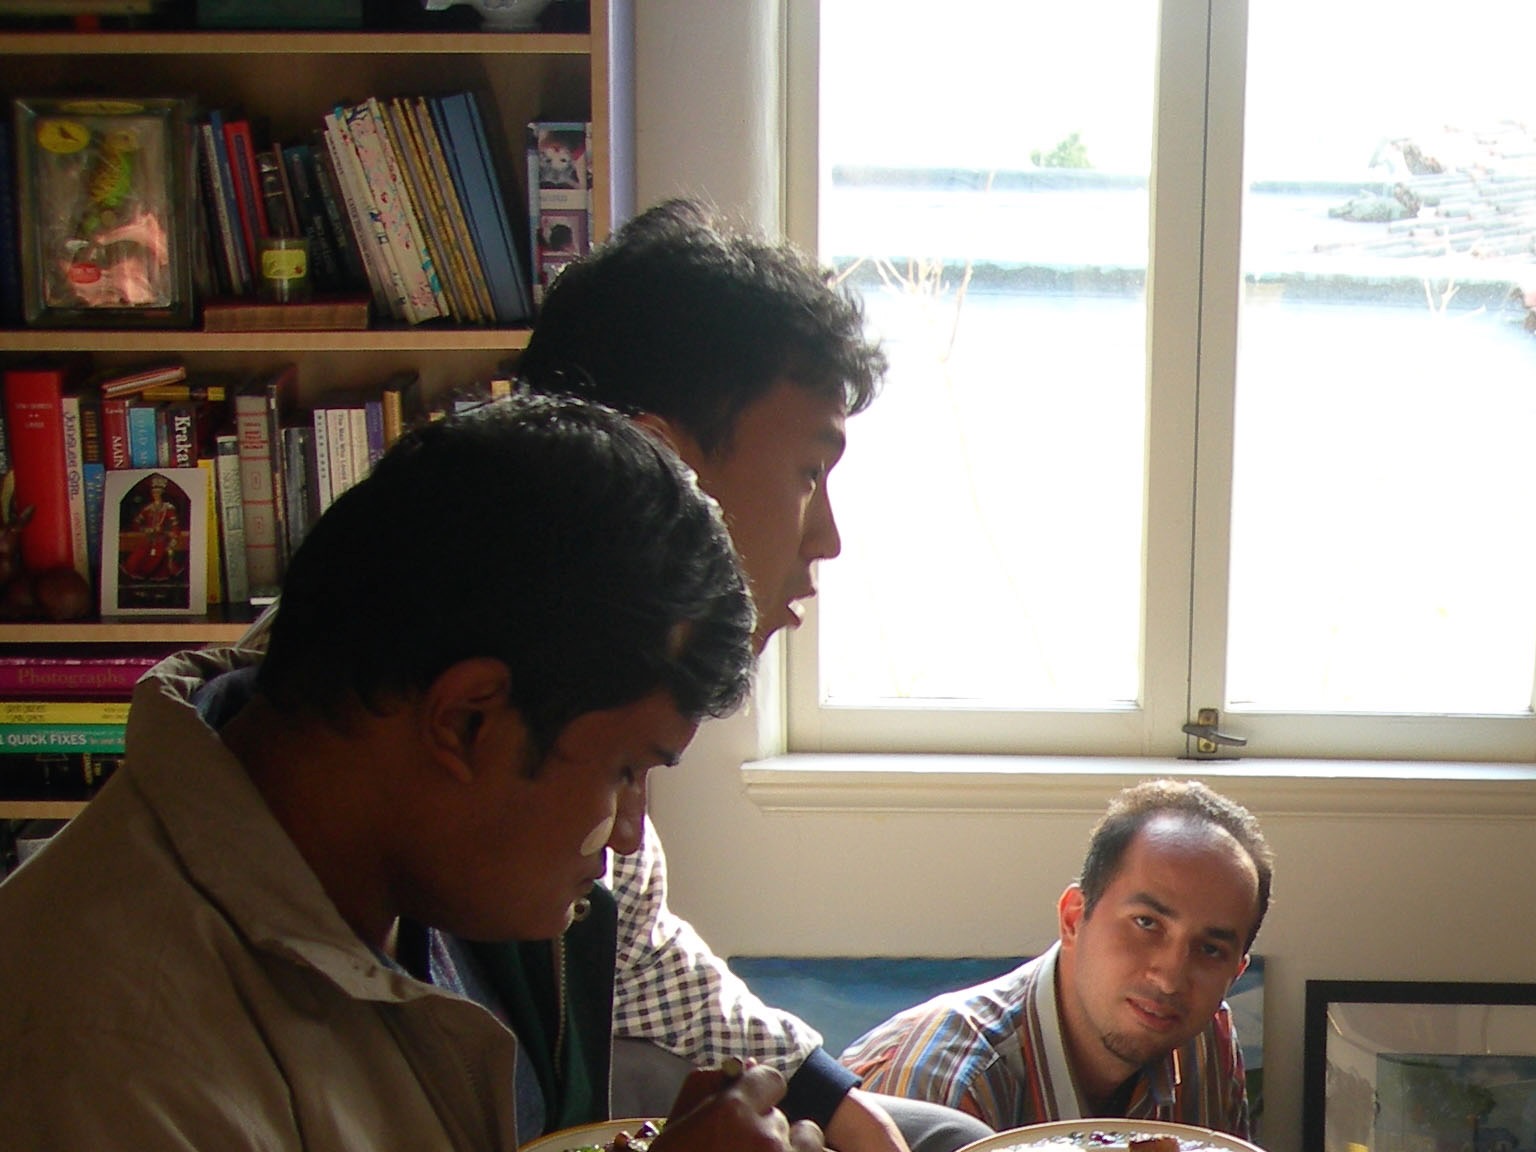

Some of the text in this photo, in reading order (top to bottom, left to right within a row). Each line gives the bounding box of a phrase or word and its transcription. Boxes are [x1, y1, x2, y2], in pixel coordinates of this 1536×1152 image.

[16, 666, 126, 688] Photographs
[8, 733, 47, 747] QUICK
[49, 733, 87, 746] FIXES
